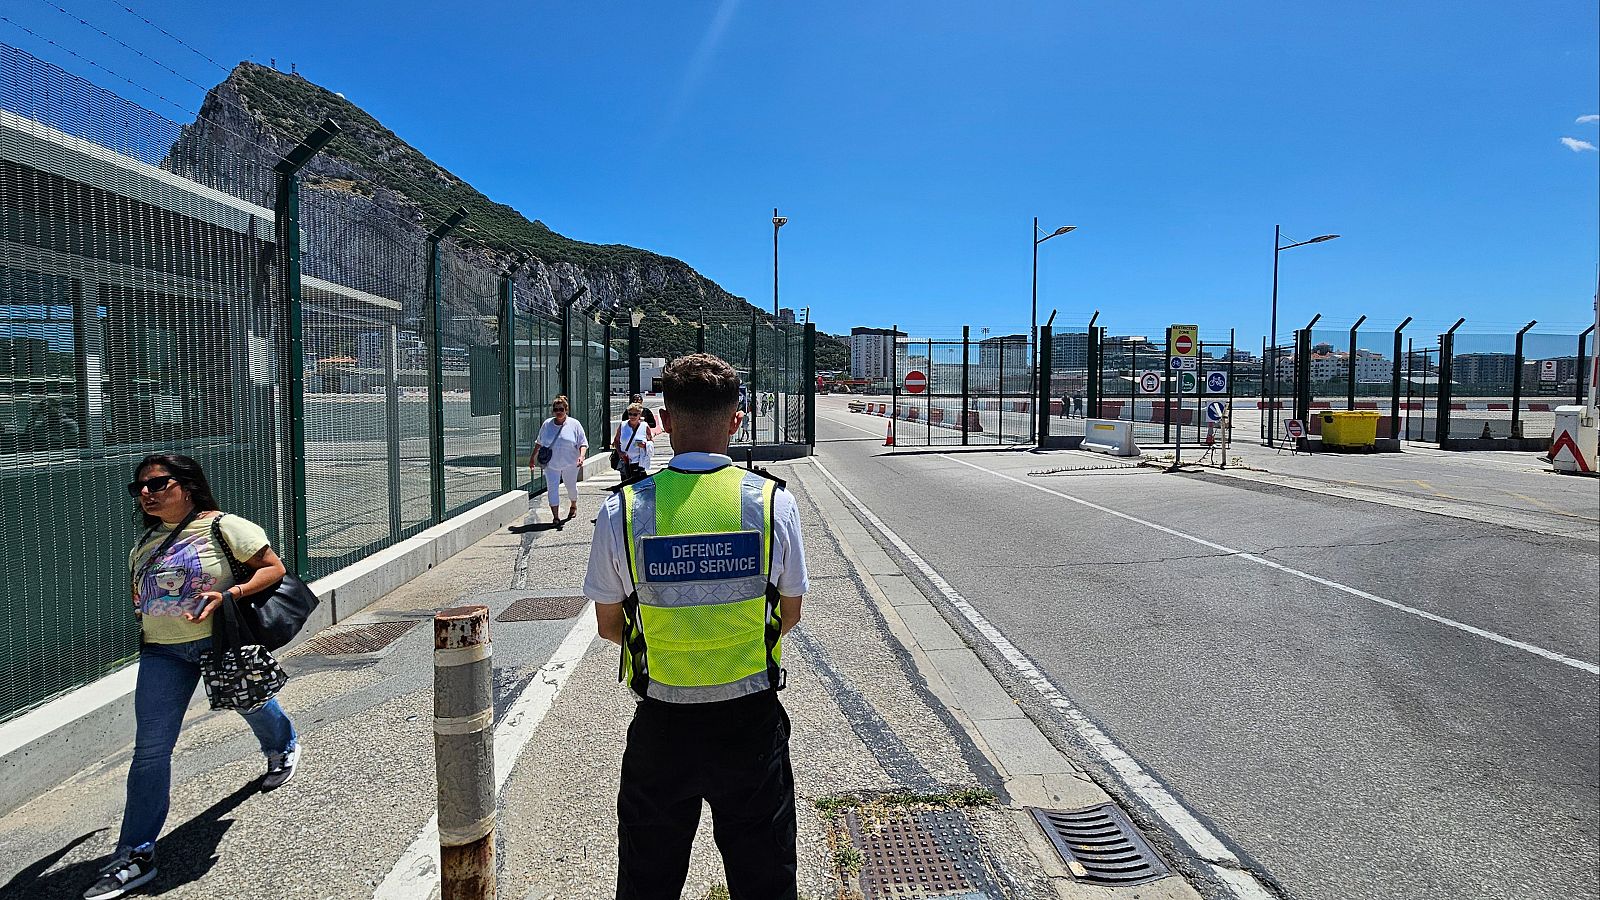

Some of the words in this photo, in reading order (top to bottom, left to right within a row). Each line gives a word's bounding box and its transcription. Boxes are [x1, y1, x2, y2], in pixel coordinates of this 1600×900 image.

[671, 542, 733, 559] DEFENCE
[648, 560, 696, 576] GUARD
[699, 556, 756, 574] SERVICE
